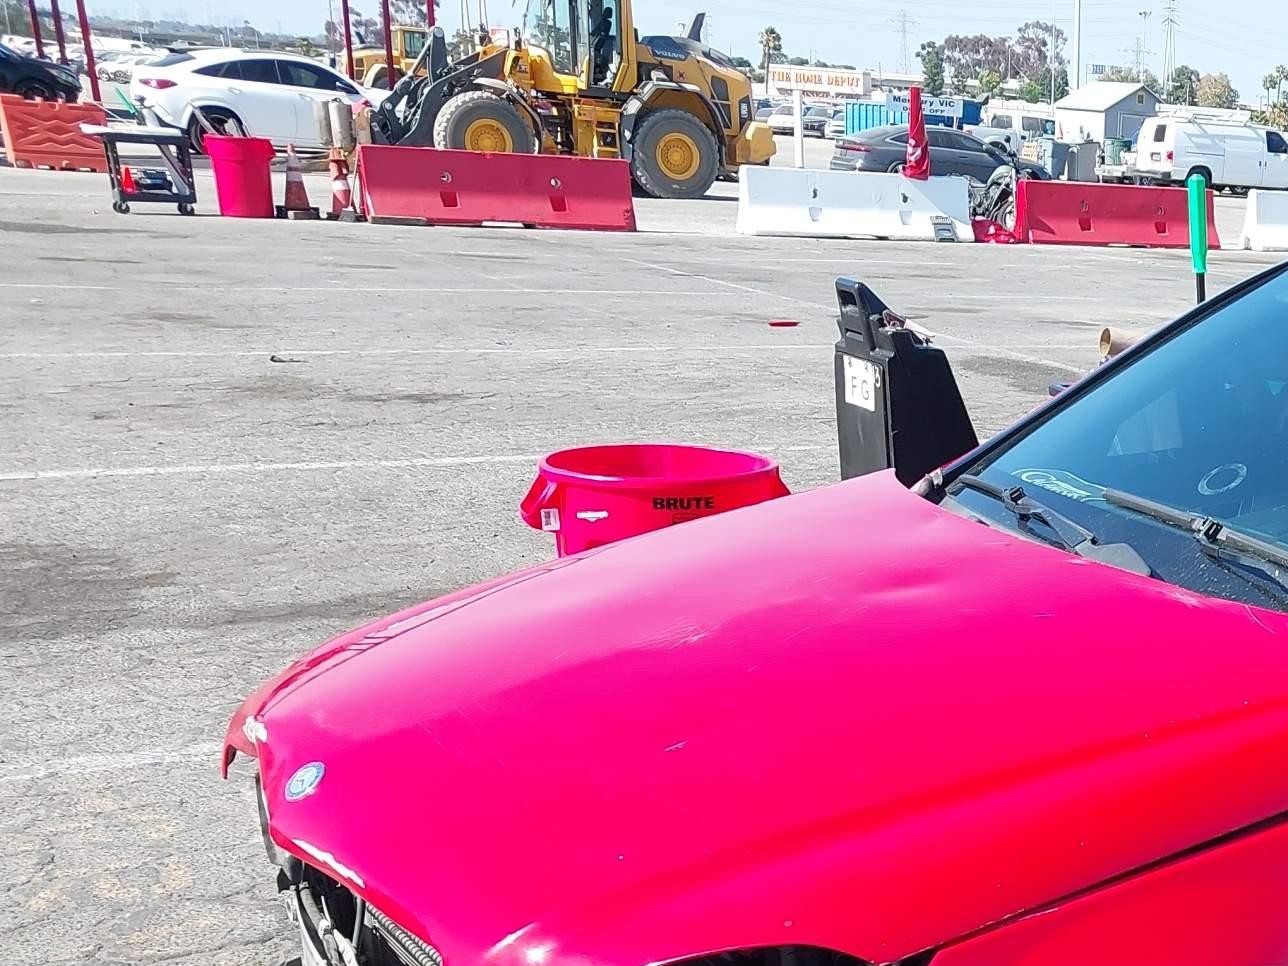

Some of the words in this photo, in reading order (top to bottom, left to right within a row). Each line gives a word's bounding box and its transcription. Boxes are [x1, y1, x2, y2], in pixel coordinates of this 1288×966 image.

[654, 49, 685, 59] VOLVO
[770, 71, 791, 82] THE
[794, 72, 823, 84] HOME
[828, 75, 861, 88] DEPOT
[938, 99, 955, 108] VIC
[653, 497, 714, 510] BRUTE
